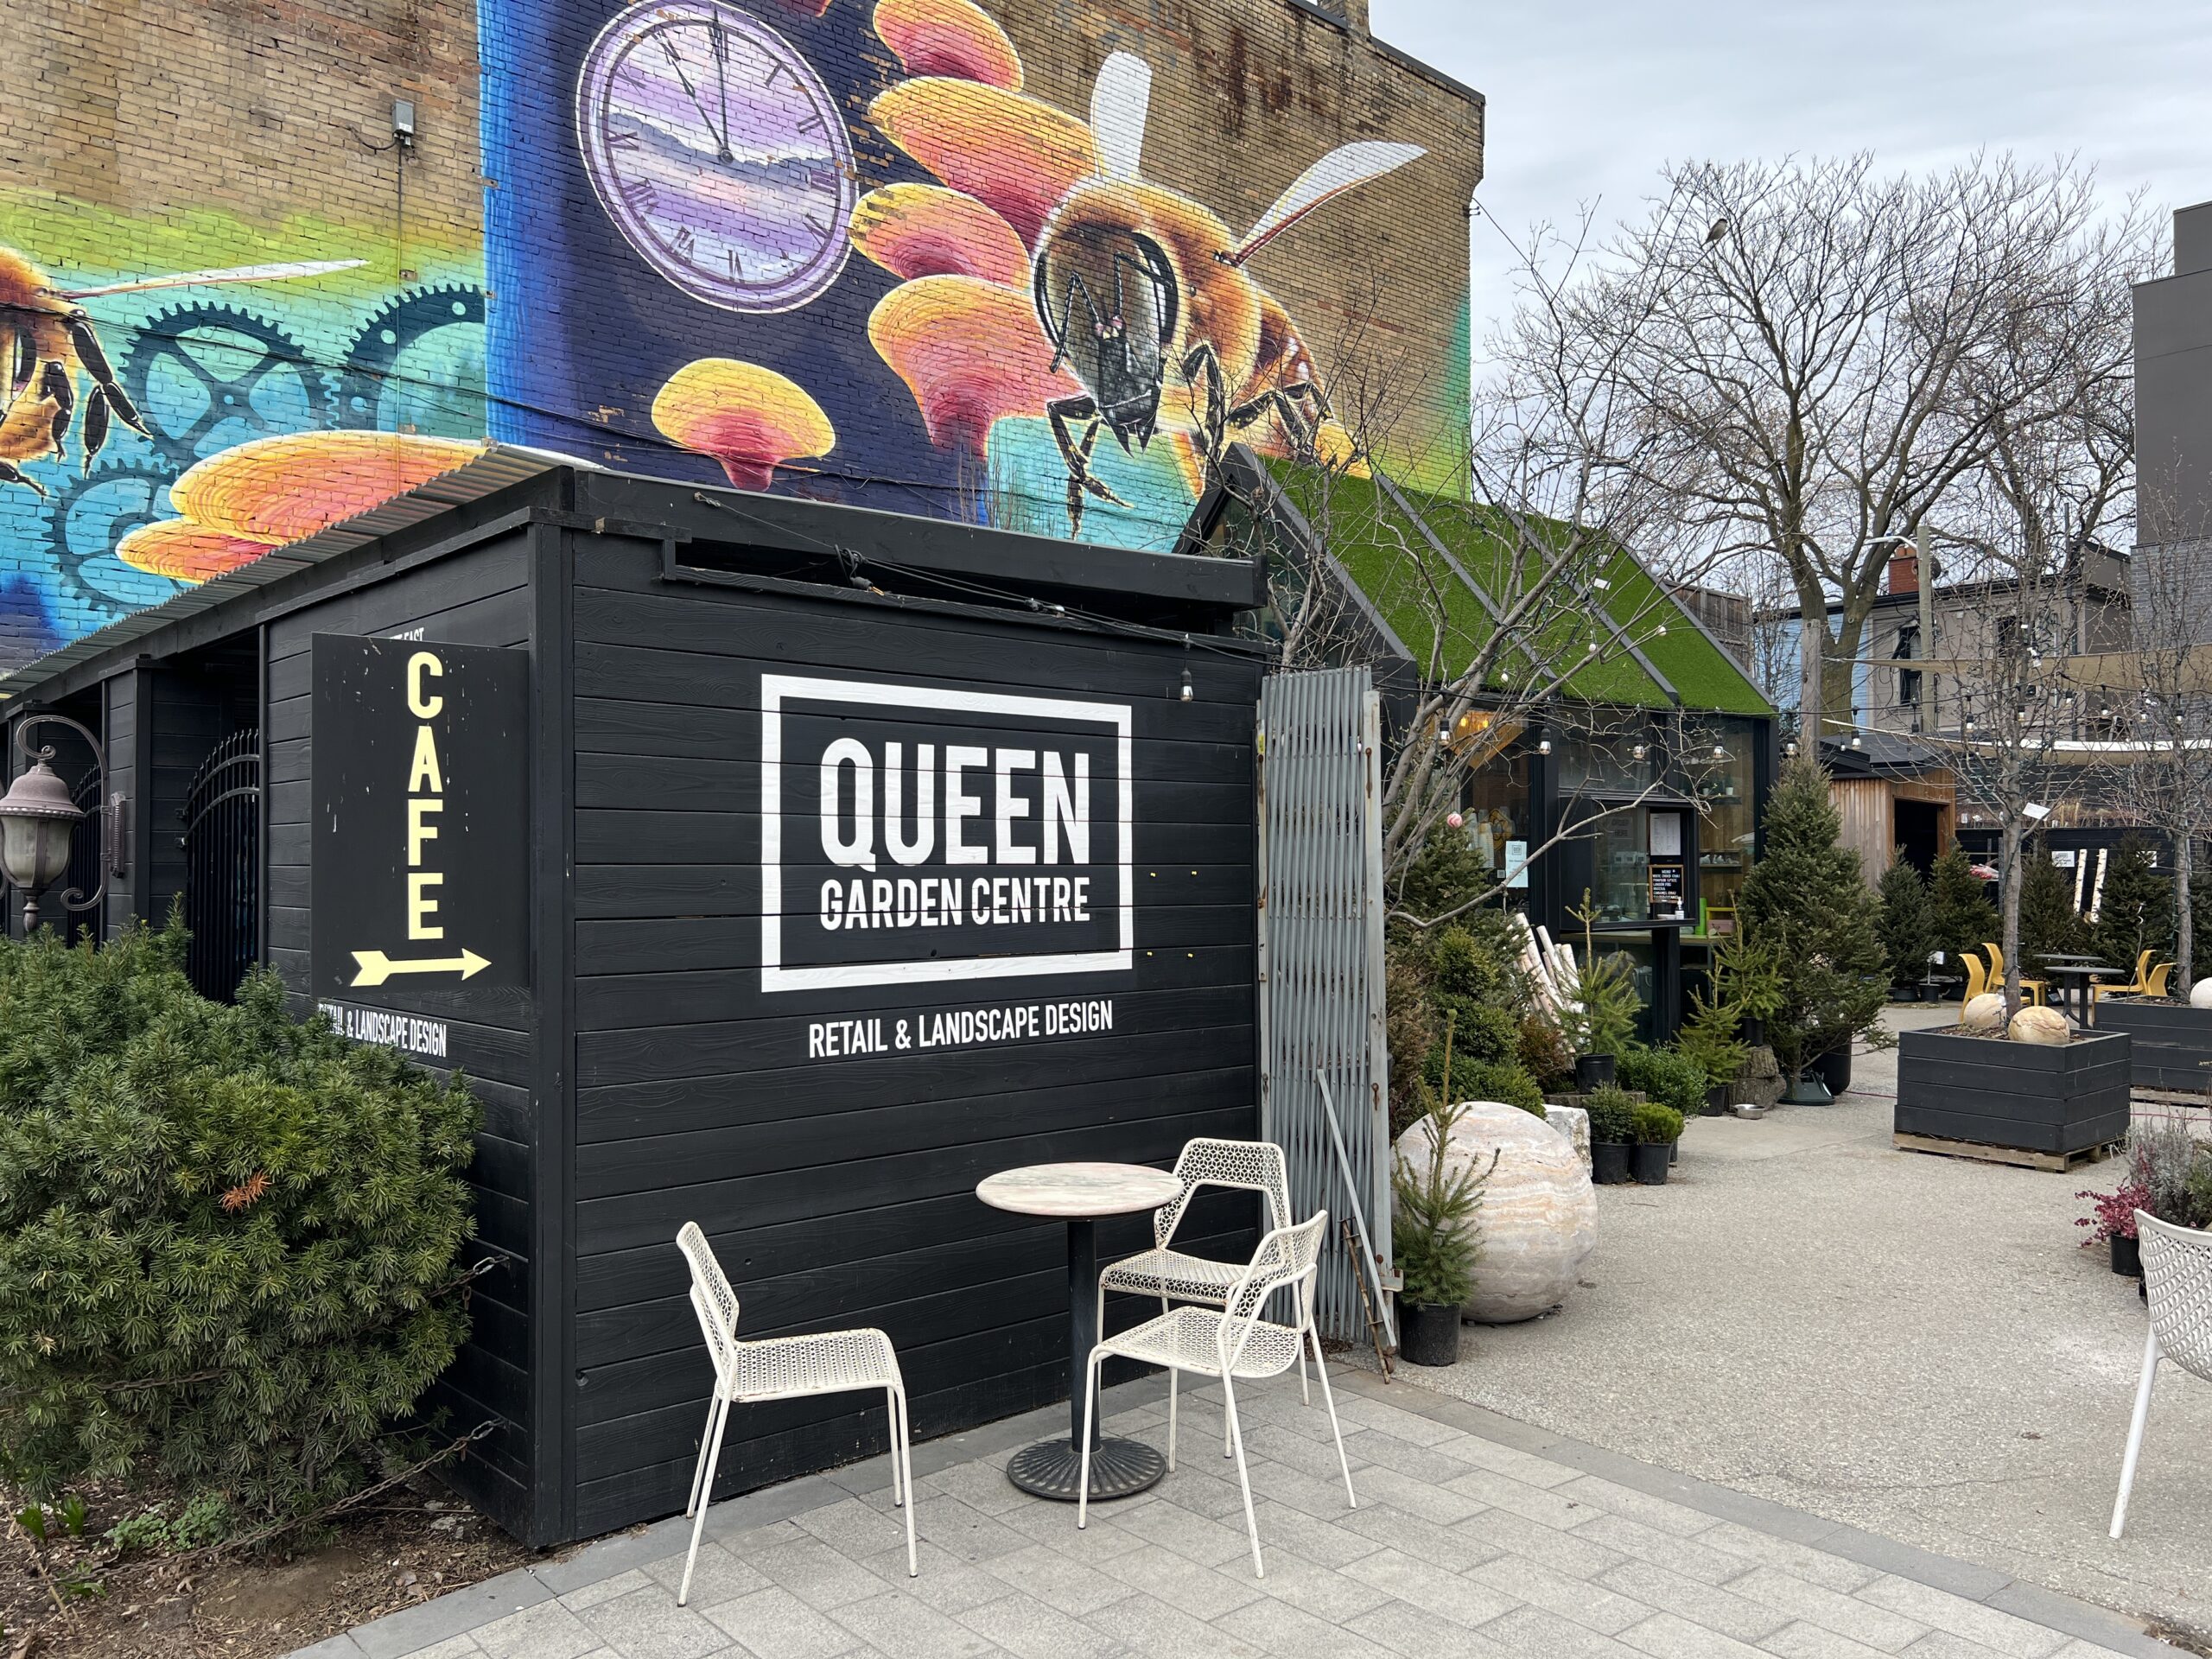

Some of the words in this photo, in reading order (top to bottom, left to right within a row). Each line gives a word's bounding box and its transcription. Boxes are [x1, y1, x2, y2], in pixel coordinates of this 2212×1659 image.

[408, 652, 443, 940] CAFE
[820, 737, 1090, 873] QUEEN
[820, 878, 963, 931] GARDEN
[971, 877, 1090, 925] CENTRE
[346, 1010, 353, 1038] &
[355, 1009, 408, 1049] LANDSCAPE
[410, 1018, 447, 1058] DESIGN
[809, 1018, 888, 1058] RETAIL
[895, 1020, 912, 1050] &
[918, 1006, 1039, 1047] LANDSCAPE
[1046, 1000, 1113, 1035] DESIGN
